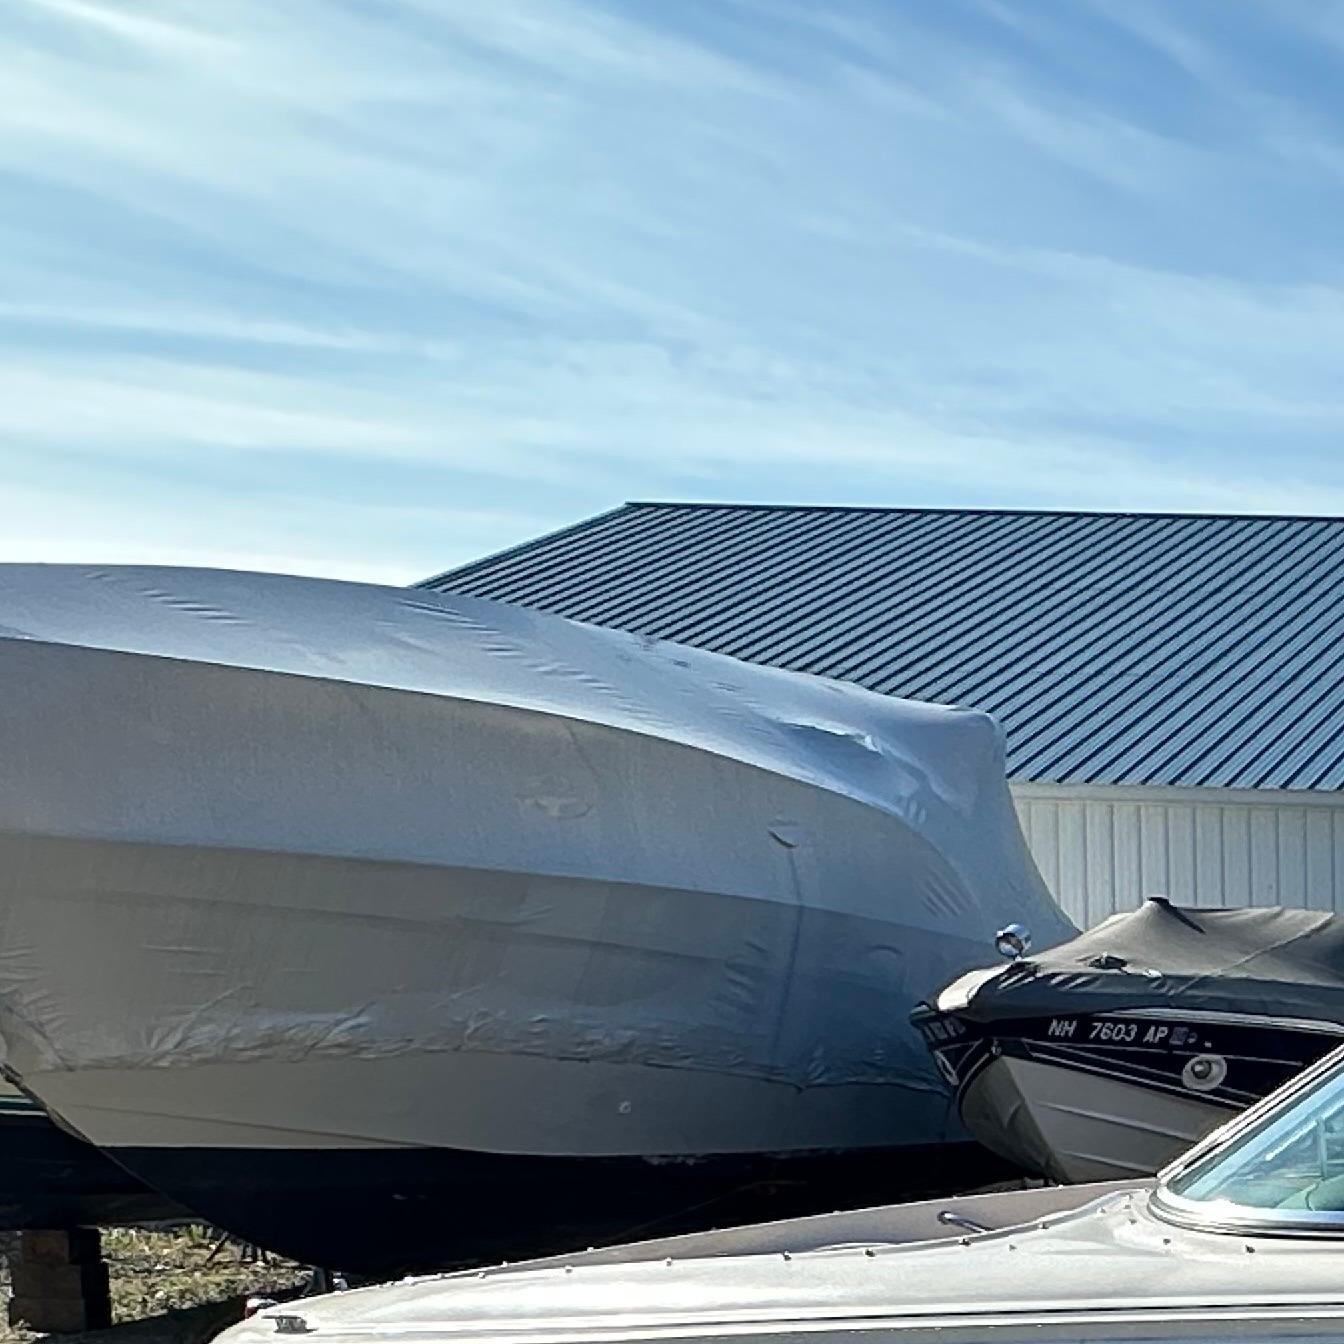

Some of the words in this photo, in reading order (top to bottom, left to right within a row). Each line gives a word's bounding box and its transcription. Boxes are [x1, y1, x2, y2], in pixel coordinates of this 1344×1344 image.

[1048, 1019, 1078, 1038] NH
[1088, 1022, 1138, 1042] 7603
[1142, 1025, 1169, 1044] AP
